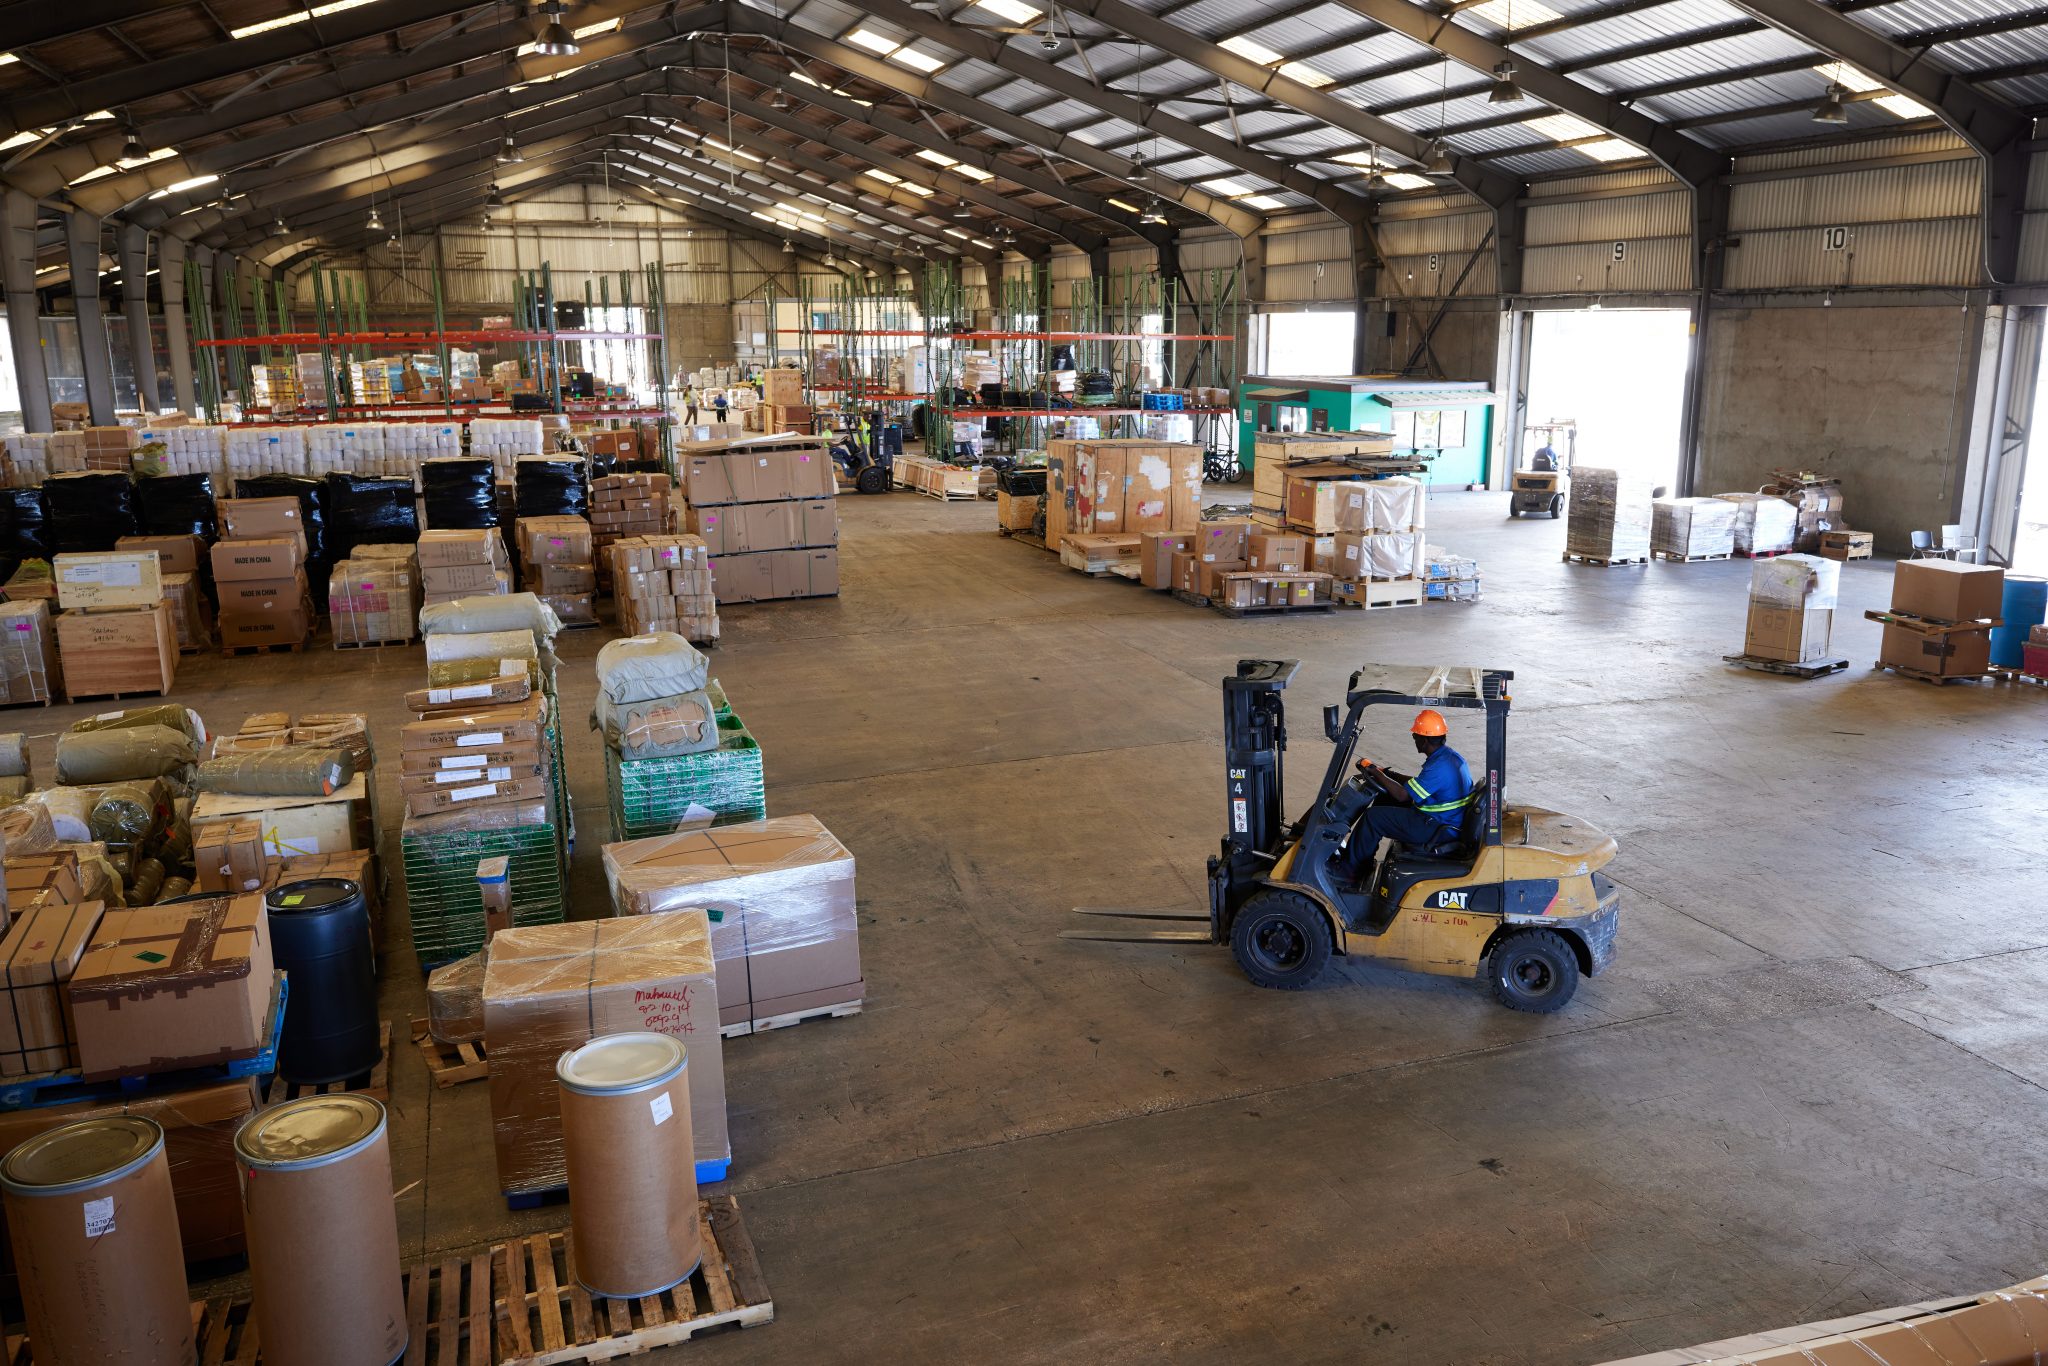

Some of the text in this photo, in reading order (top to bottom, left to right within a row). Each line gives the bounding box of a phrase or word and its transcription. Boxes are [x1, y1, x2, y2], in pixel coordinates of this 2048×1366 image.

[1826, 228, 1846, 250] 10
[1614, 242, 1625, 261] 9
[1430, 255, 1437, 270] 8
[234, 557, 249, 565] MADE
[255, 556, 272, 564] CHINA
[240, 590, 255, 598] MADE
[261, 589, 278, 597] CHINA
[238, 625, 253, 633] MADE
[259, 624, 275, 632] CHINA
[1230, 769, 1246, 779] CAT
[1491, 771, 1497, 784] NO
[1234, 782, 1243, 795] 4
[1438, 891, 1468, 909] CAT
[87, 1216, 114, 1228] 342707
